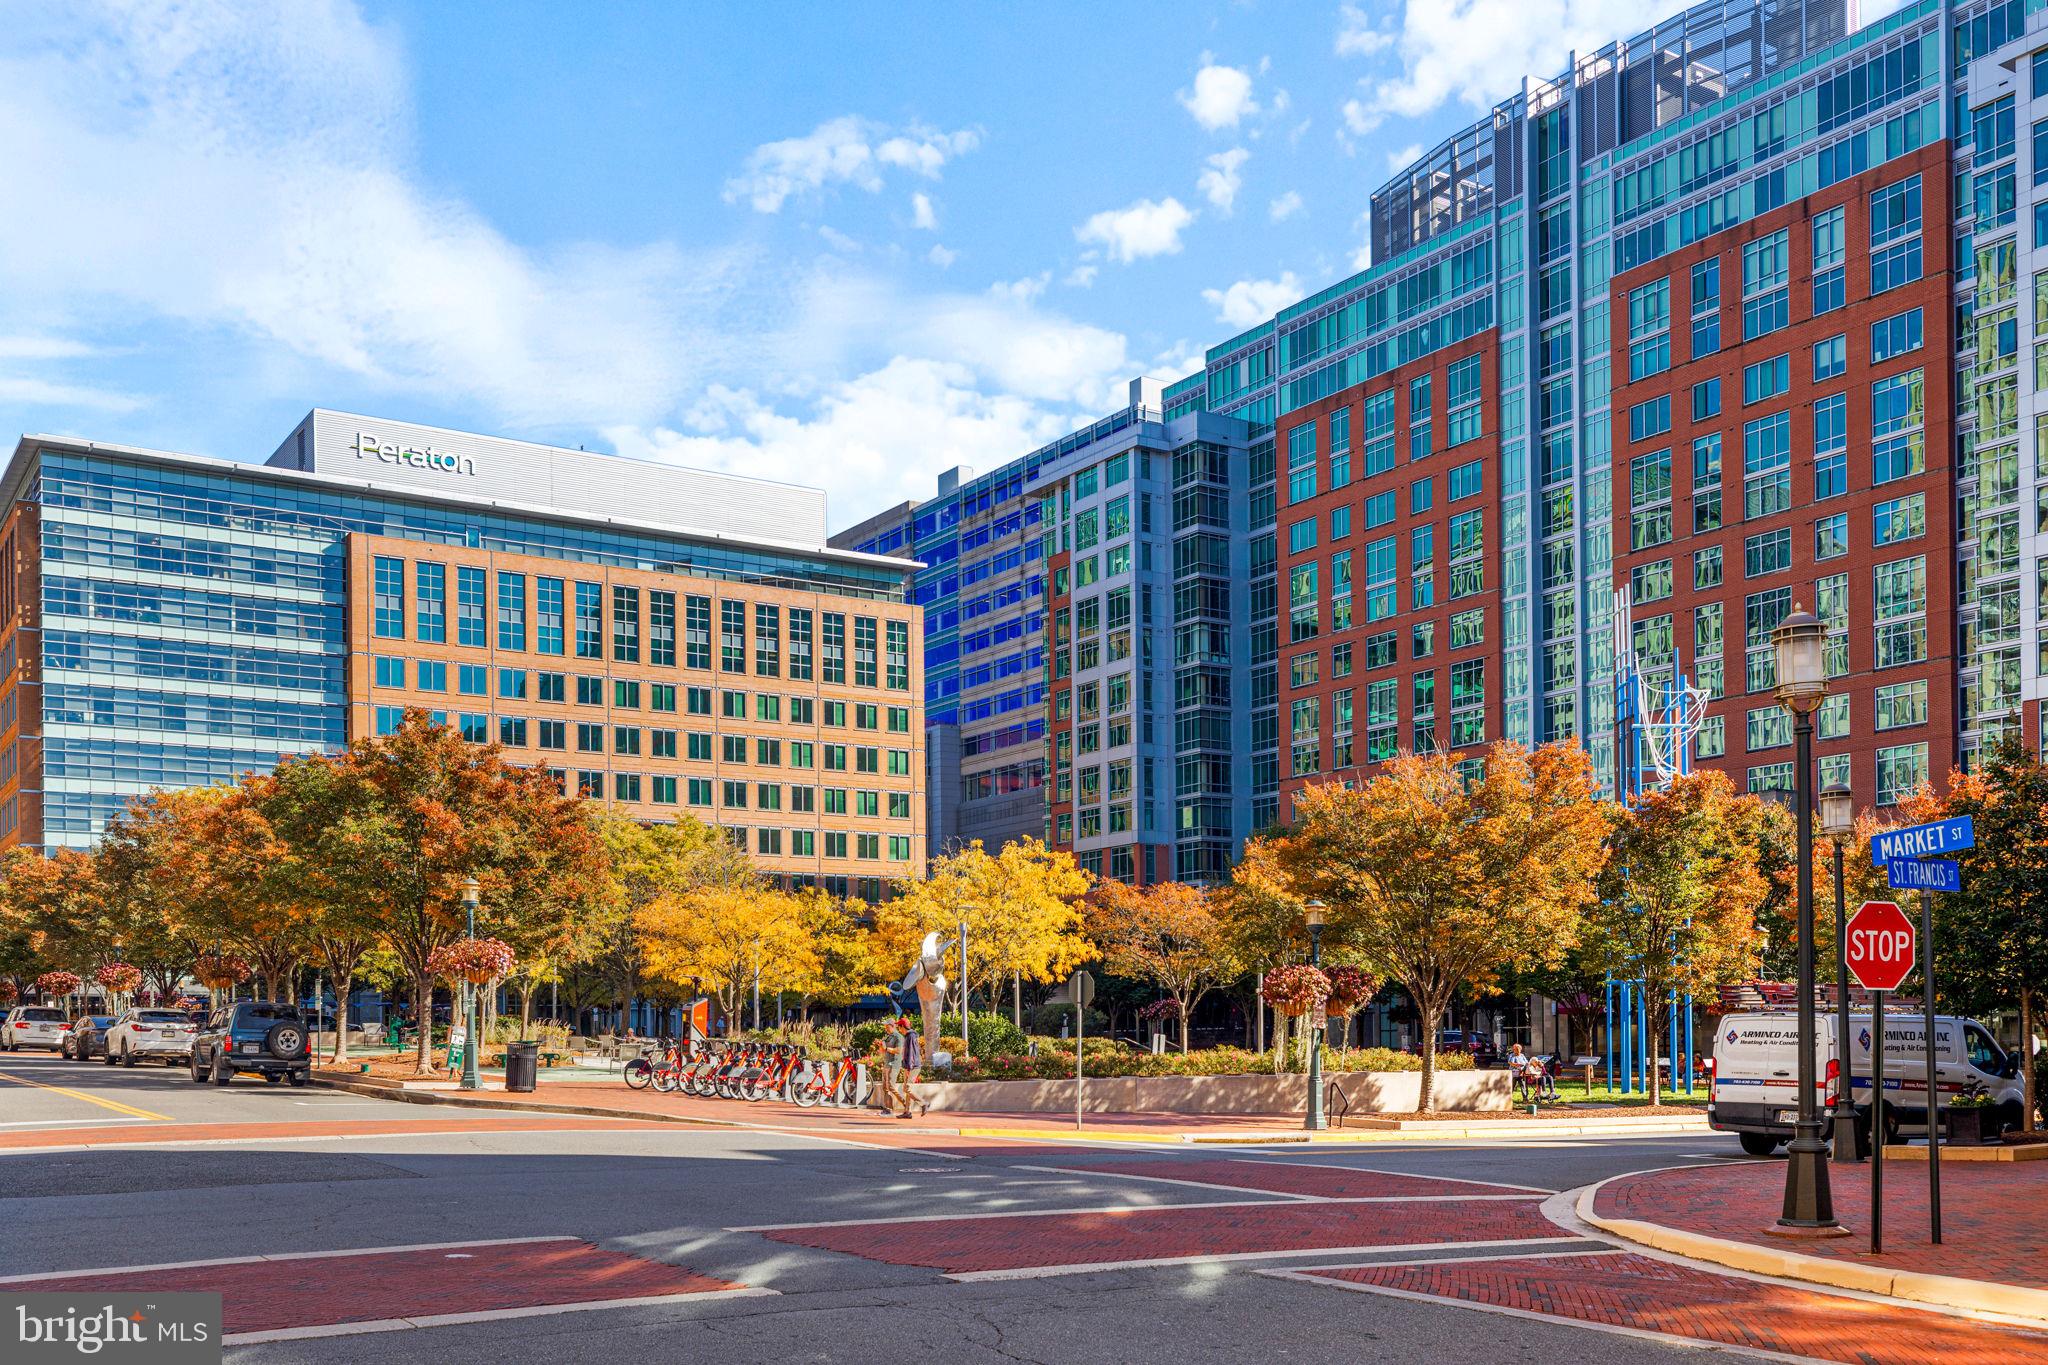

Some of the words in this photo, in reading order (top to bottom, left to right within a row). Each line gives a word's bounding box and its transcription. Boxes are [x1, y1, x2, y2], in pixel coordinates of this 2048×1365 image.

[355, 431, 476, 476] Peraton
[1880, 825, 1945, 860] MARKET
[1952, 826, 1962, 841] ST
[1948, 870, 1954, 882] ST
[1850, 929, 1910, 962] STOP
[1740, 1030, 1781, 1039] ARMINCO
[1884, 1031, 1916, 1041] RMINCO
[1936, 1032, 1950, 1042] INC
[1884, 1045, 1901, 1053] ating
